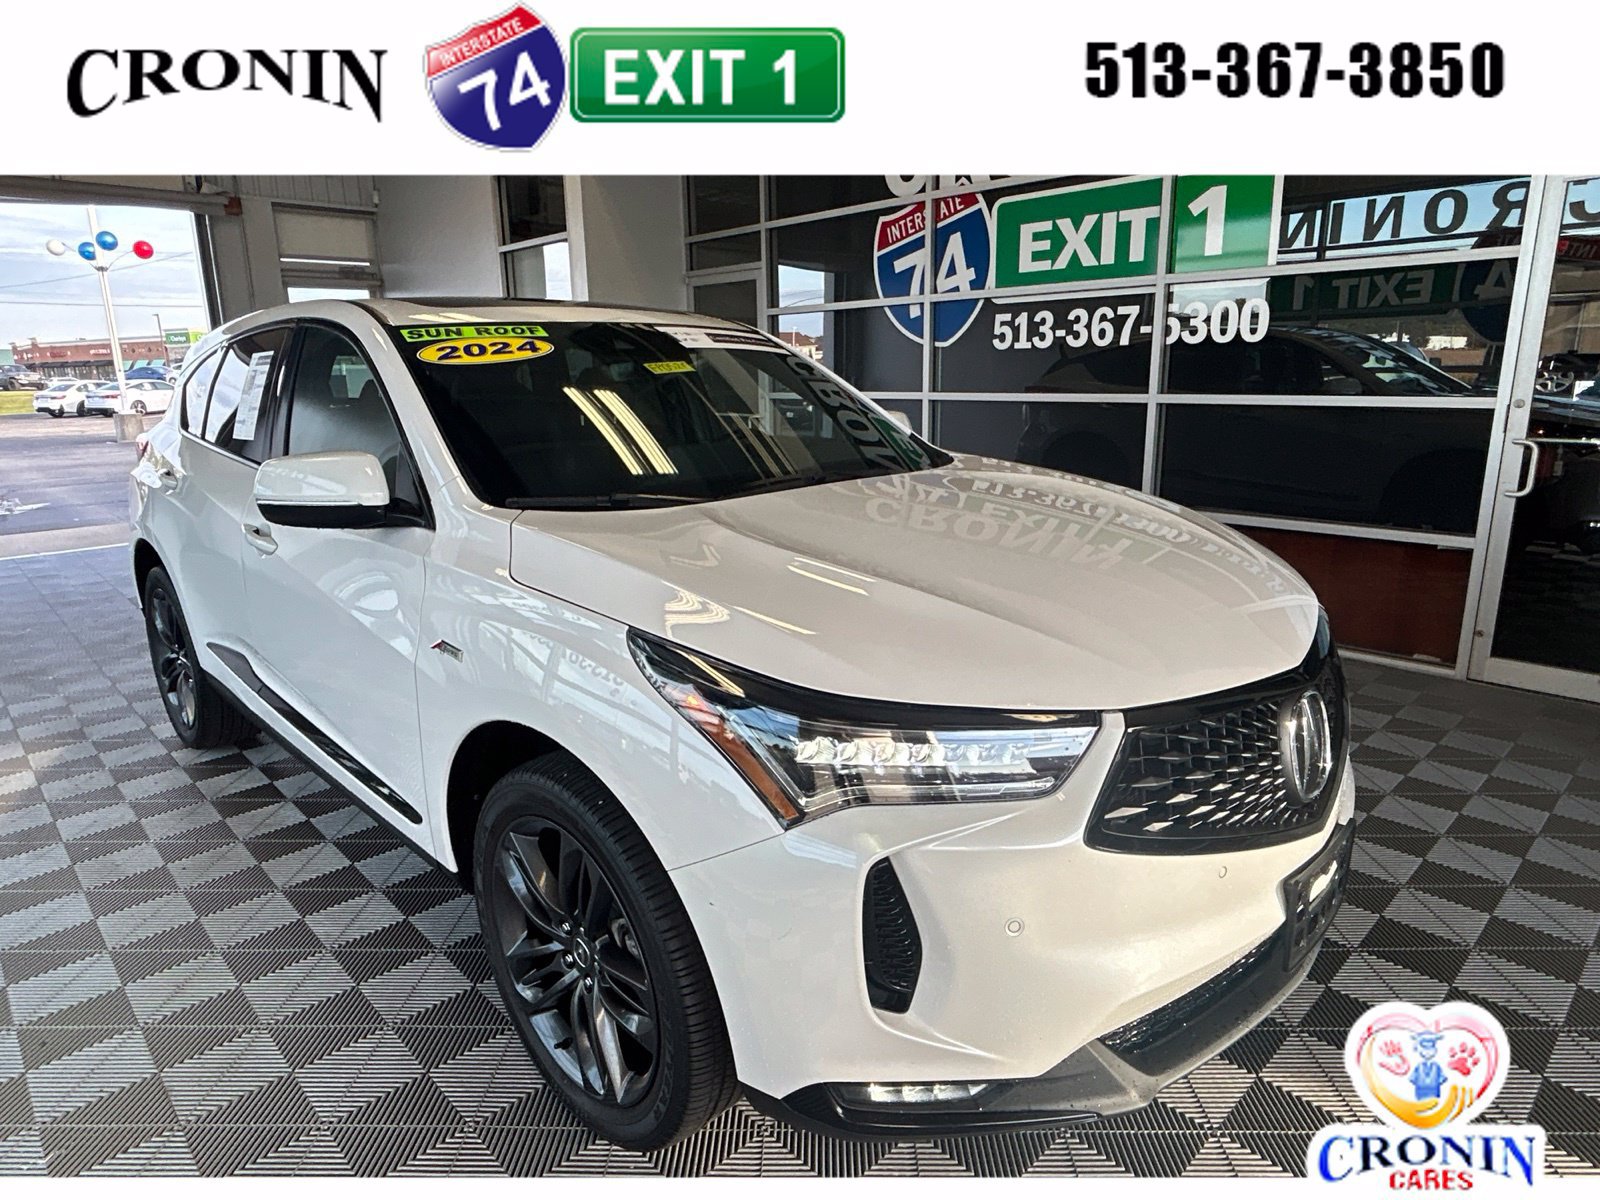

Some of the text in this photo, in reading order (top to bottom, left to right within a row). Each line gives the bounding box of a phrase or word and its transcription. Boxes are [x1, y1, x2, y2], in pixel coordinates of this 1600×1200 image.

[887, 197, 965, 244] INTERATE
[1018, 185, 1228, 273] EXIT 1
[893, 231, 976, 319] 74
[406, 326, 541, 340] SUN ROOF
[992, 298, 1270, 350] 513-367-5300
[436, 338, 542, 361] 2024
